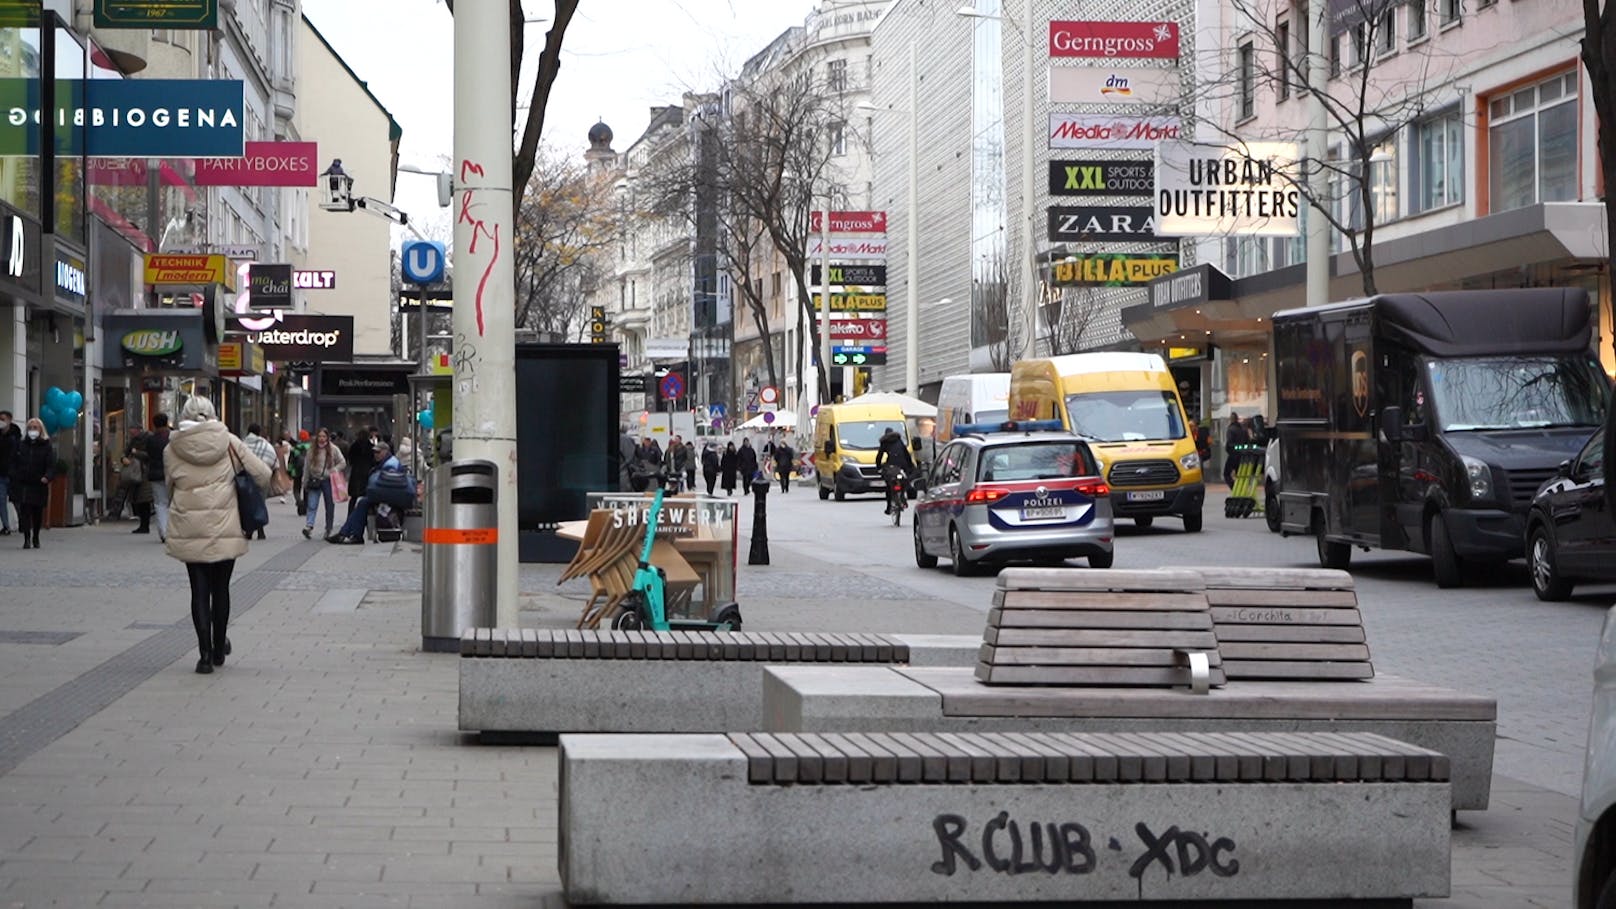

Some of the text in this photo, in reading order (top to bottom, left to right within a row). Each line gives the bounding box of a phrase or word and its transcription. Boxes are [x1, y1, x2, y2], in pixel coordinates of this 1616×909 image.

[1053, 31, 1154, 55] Gerngross
[1105, 74, 1128, 88] dm
[92, 107, 238, 127] BIOGENA
[1051, 121, 1179, 141] Media Markt
[203, 157, 309, 171] PARTYBOXES
[1189, 158, 1272, 186] URBAN
[1064, 166, 1106, 189] XXL
[1108, 167, 1146, 177] SPORTS
[1107, 179, 1154, 190] OUTDOO
[1159, 190, 1298, 218] OUTFITTERS
[1058, 214, 1154, 233] ZARA
[154, 257, 205, 267] TECHNIK
[409, 249, 436, 277] U
[162, 271, 209, 280] modern
[1132, 265, 1171, 278] PLUS
[859, 297, 883, 306] PLUS
[127, 331, 178, 348] LUSH
[1023, 497, 1063, 507] POLIZEI
[931, 814, 982, 876] R
[982, 811, 1097, 875] CLUB
